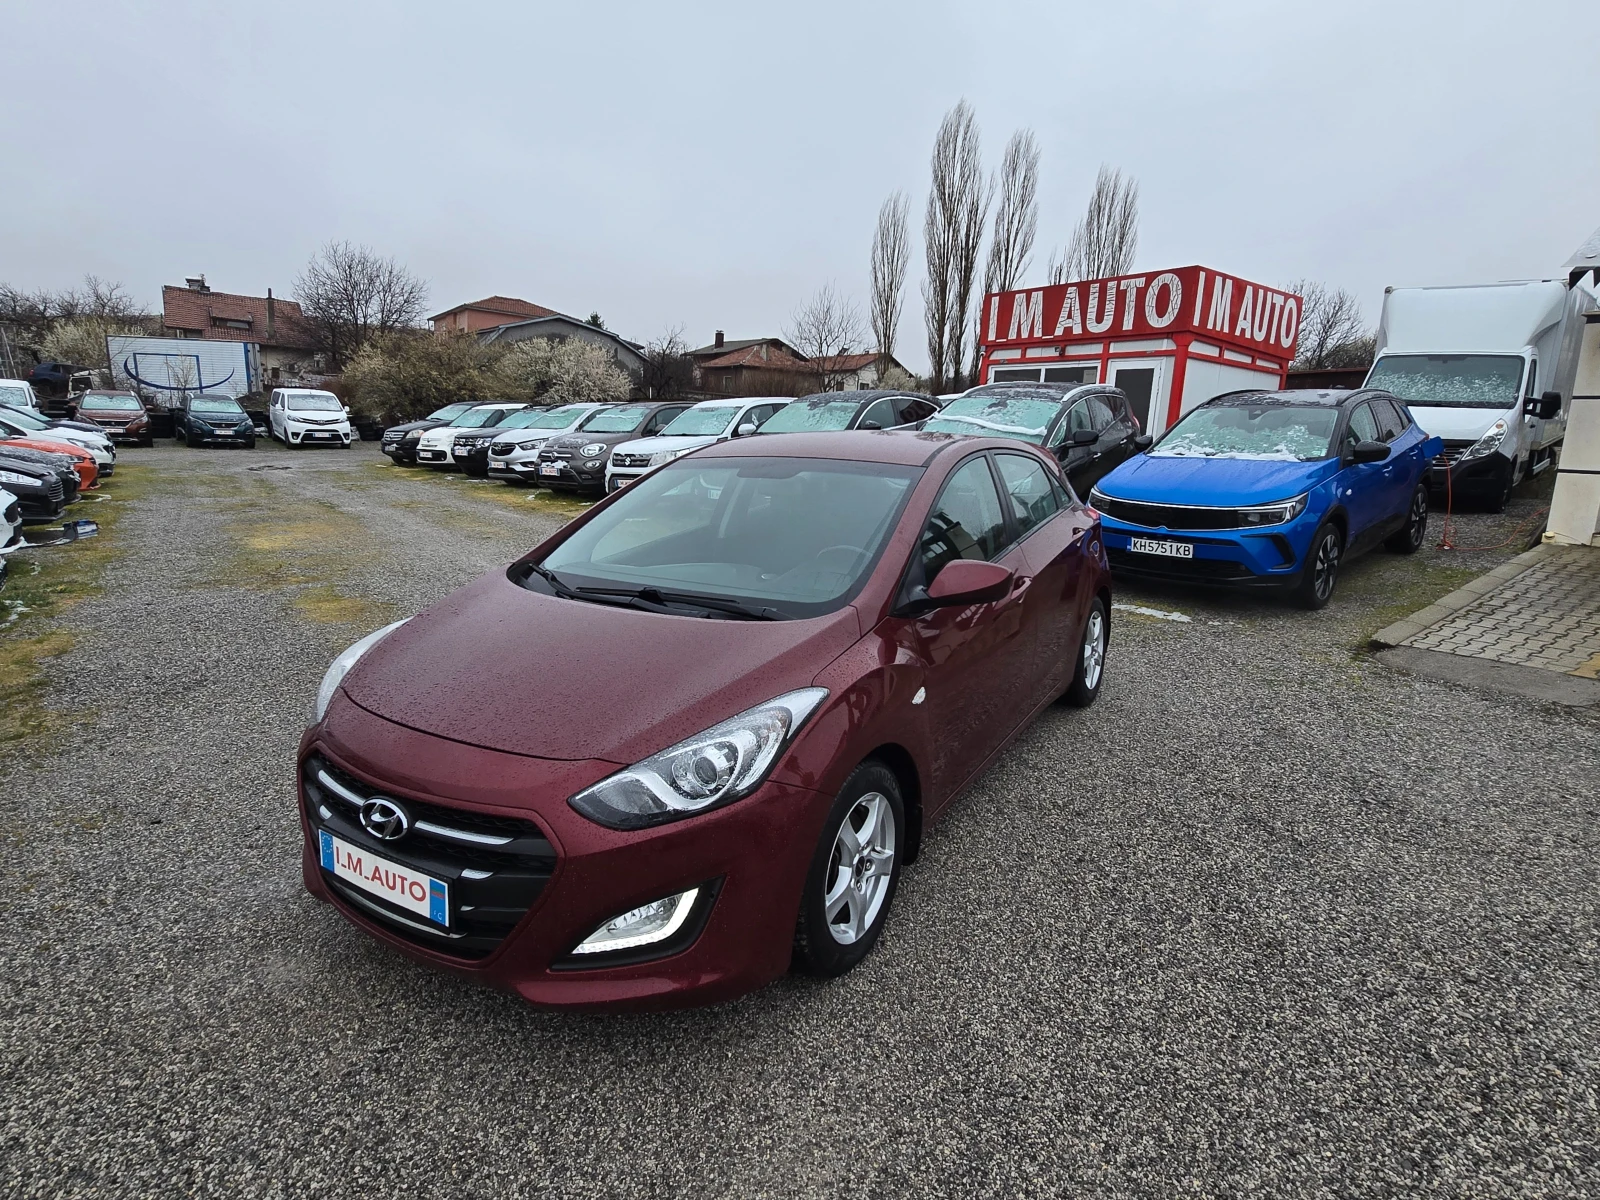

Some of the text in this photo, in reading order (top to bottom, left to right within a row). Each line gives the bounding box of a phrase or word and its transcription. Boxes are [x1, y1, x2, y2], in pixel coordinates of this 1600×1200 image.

[1193, 271, 1298, 349] I M AUTO
[1132, 539, 1191, 557] KH5751KB
